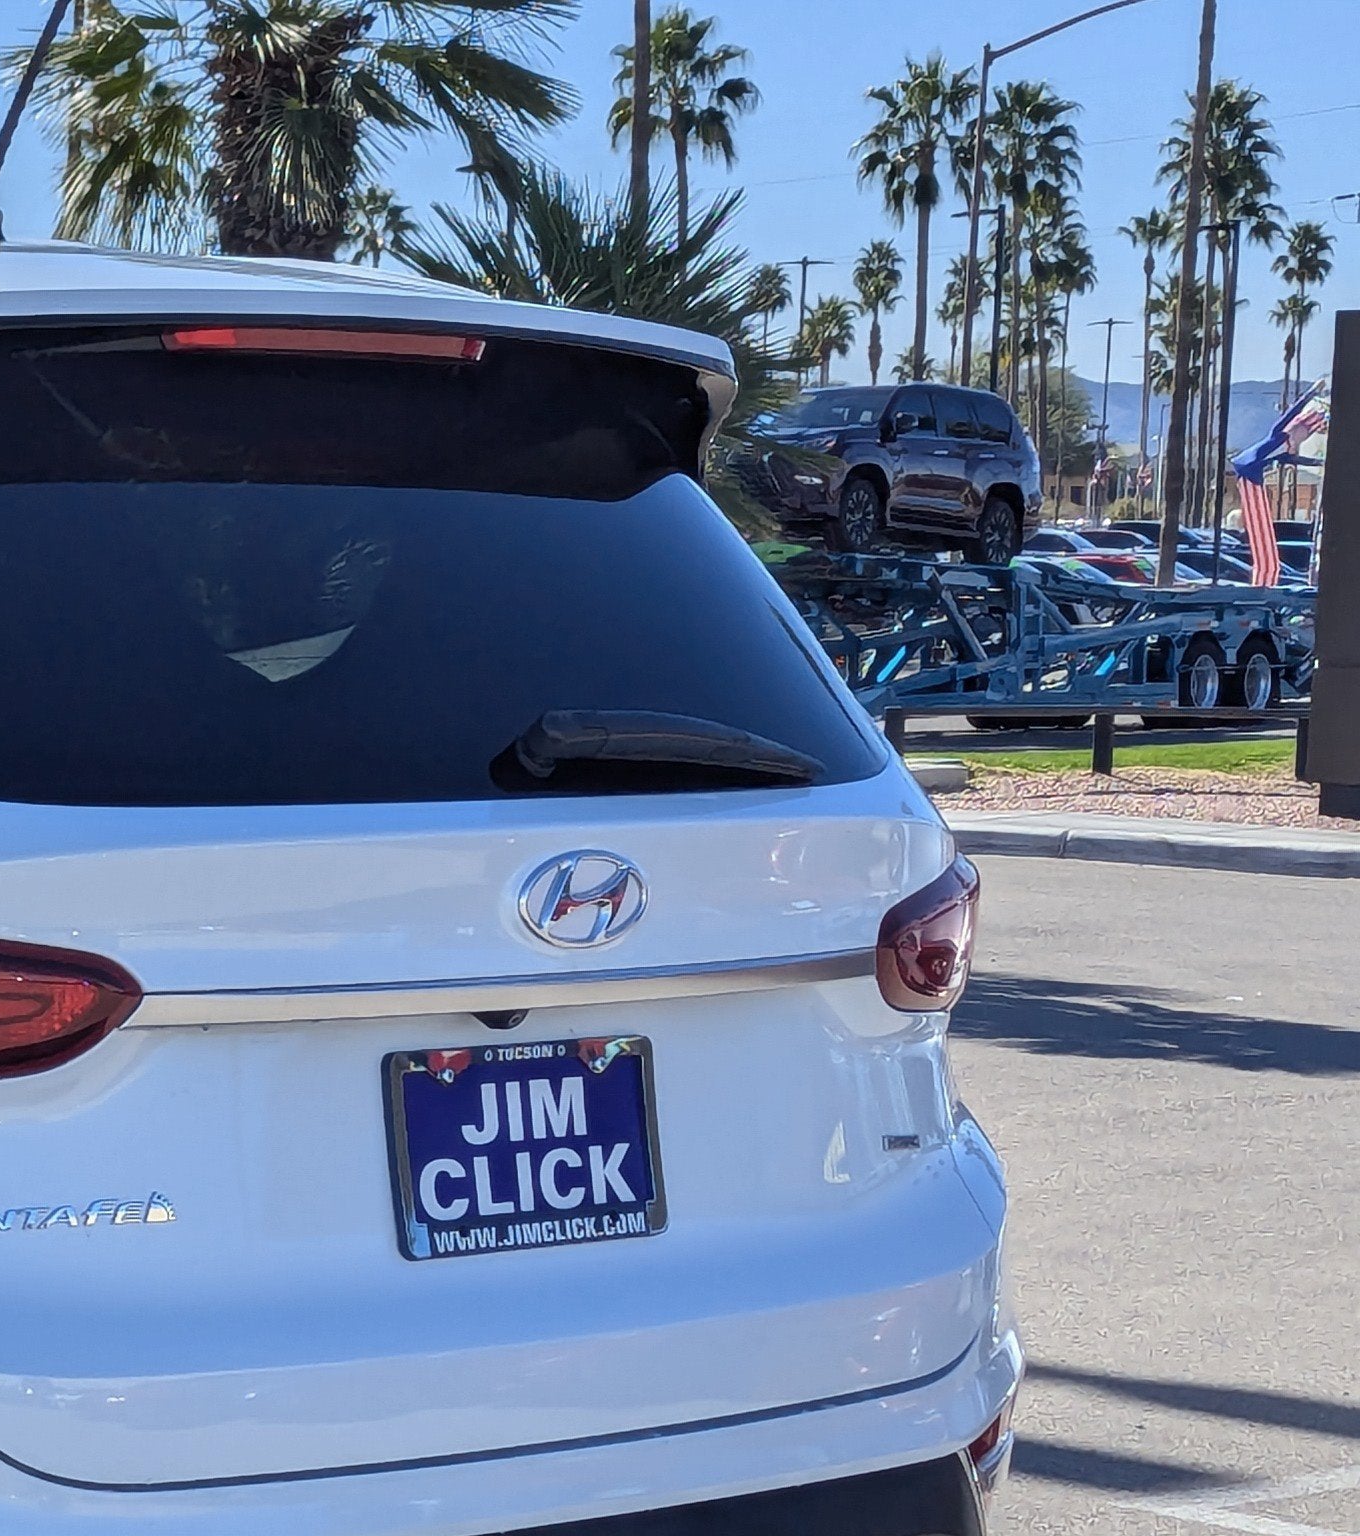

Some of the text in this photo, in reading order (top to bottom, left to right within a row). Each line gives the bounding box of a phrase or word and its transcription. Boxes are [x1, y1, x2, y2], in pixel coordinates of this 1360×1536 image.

[497, 1044, 554, 1062] TUCSON
[461, 1076, 587, 1145] JIM
[419, 1143, 636, 1221] CLICK
[433, 1211, 646, 1254] WWW.JIMCLICK.COM
